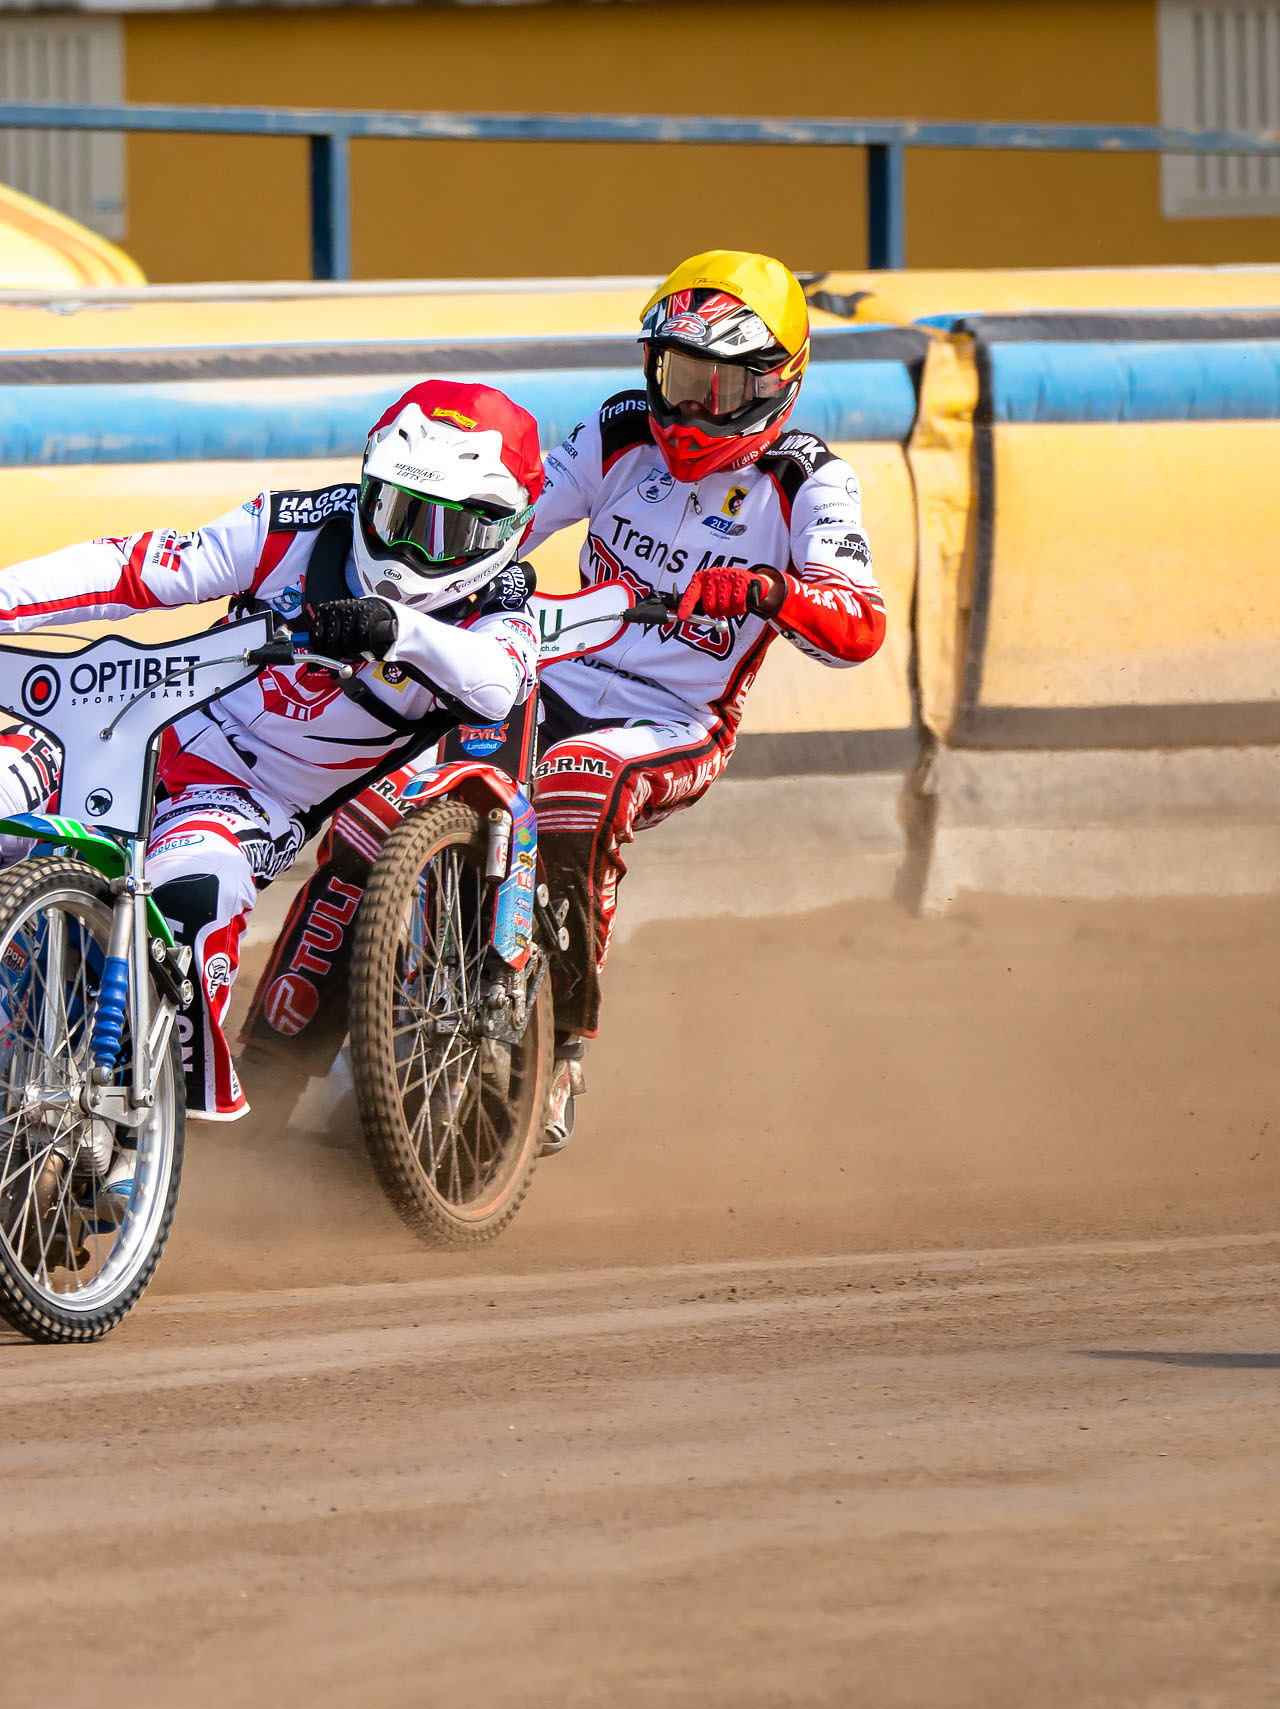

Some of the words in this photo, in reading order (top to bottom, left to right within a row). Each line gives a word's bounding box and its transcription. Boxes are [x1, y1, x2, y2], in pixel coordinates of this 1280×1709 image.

[665, 319, 703, 335] STS
[600, 398, 647, 423] Trans
[393, 462, 434, 479] MERIDIAN
[396, 469, 422, 482] LIFTS
[611, 513, 689, 574] Trans
[540, 644, 561, 653] ch.de
[70, 655, 200, 695] OPTIBET
[71, 693, 137, 706] SPORTA
[458, 722, 511, 744] DEVILS
[467, 742, 498, 751] Landshut
